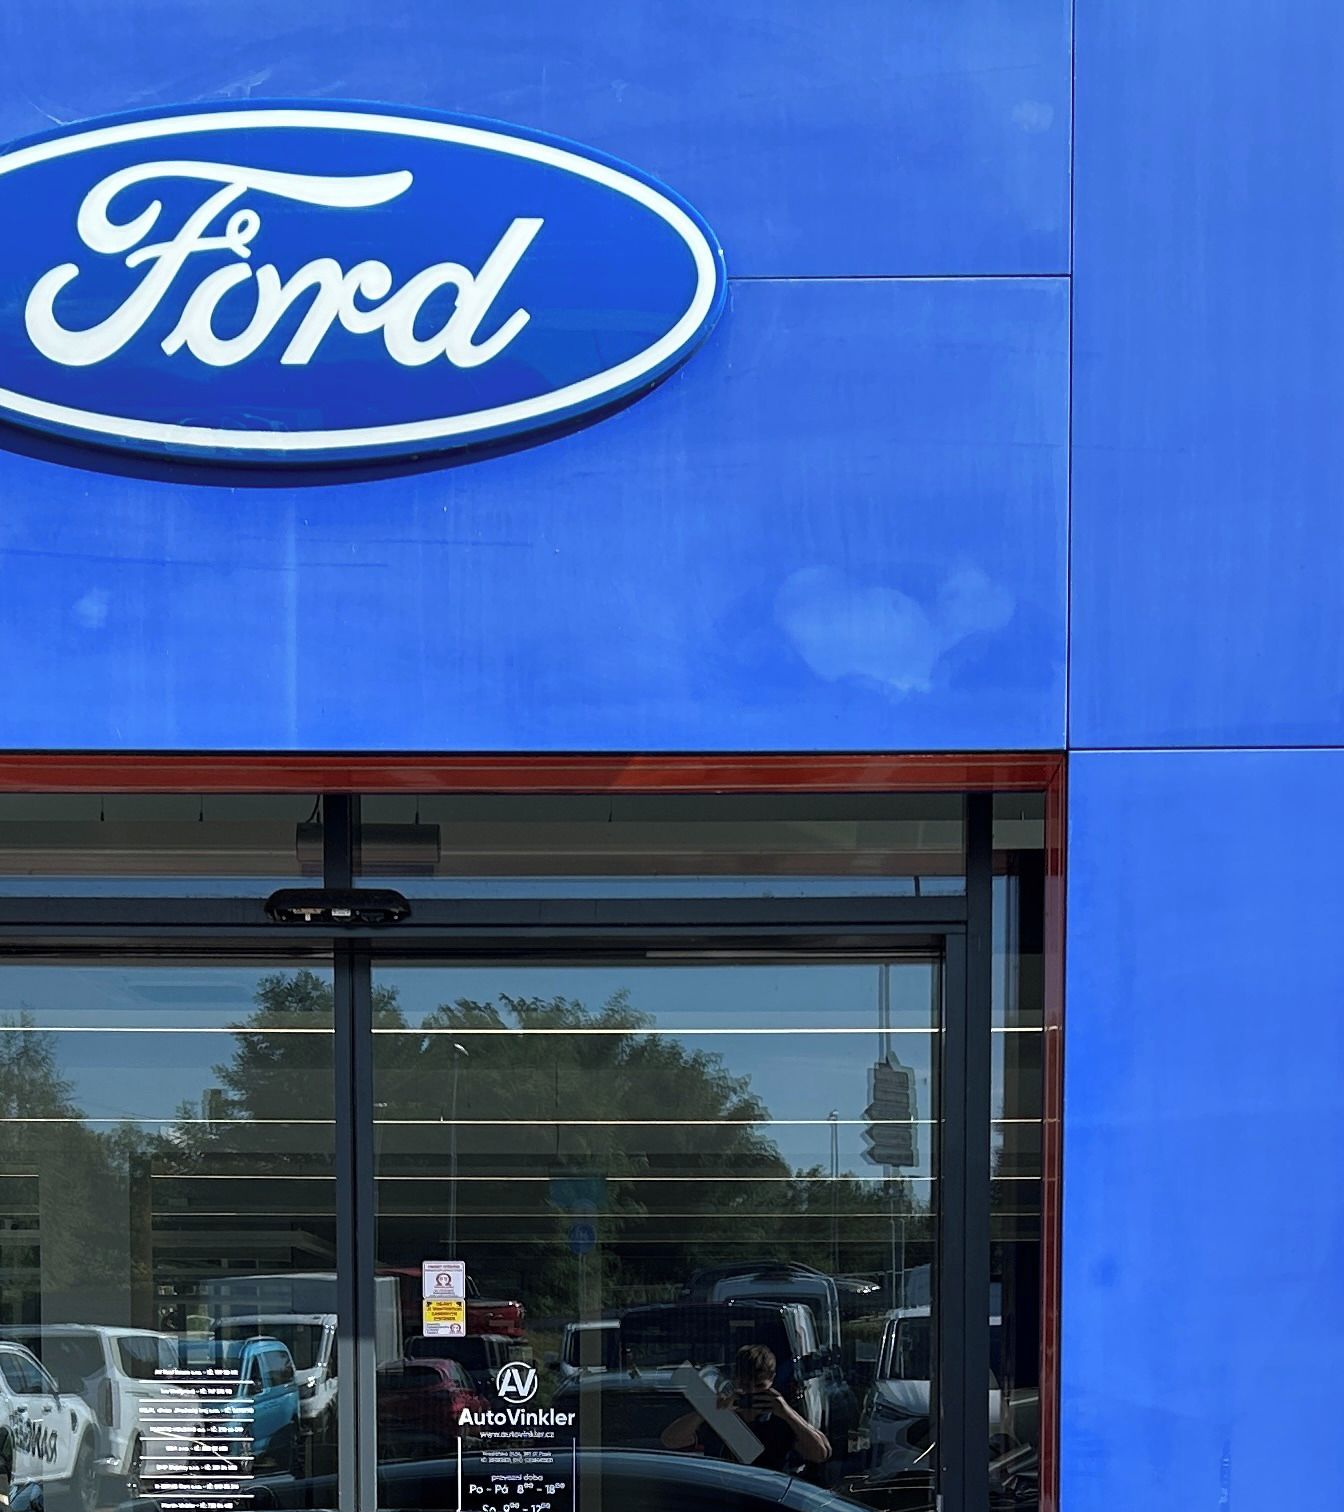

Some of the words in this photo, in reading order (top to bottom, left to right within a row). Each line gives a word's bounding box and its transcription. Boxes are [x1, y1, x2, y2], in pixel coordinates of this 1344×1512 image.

[25, 160, 544, 367] Ford
[458, 1408, 576, 1426] AutoVinkler
[469, 1484, 484, 1494] Po
